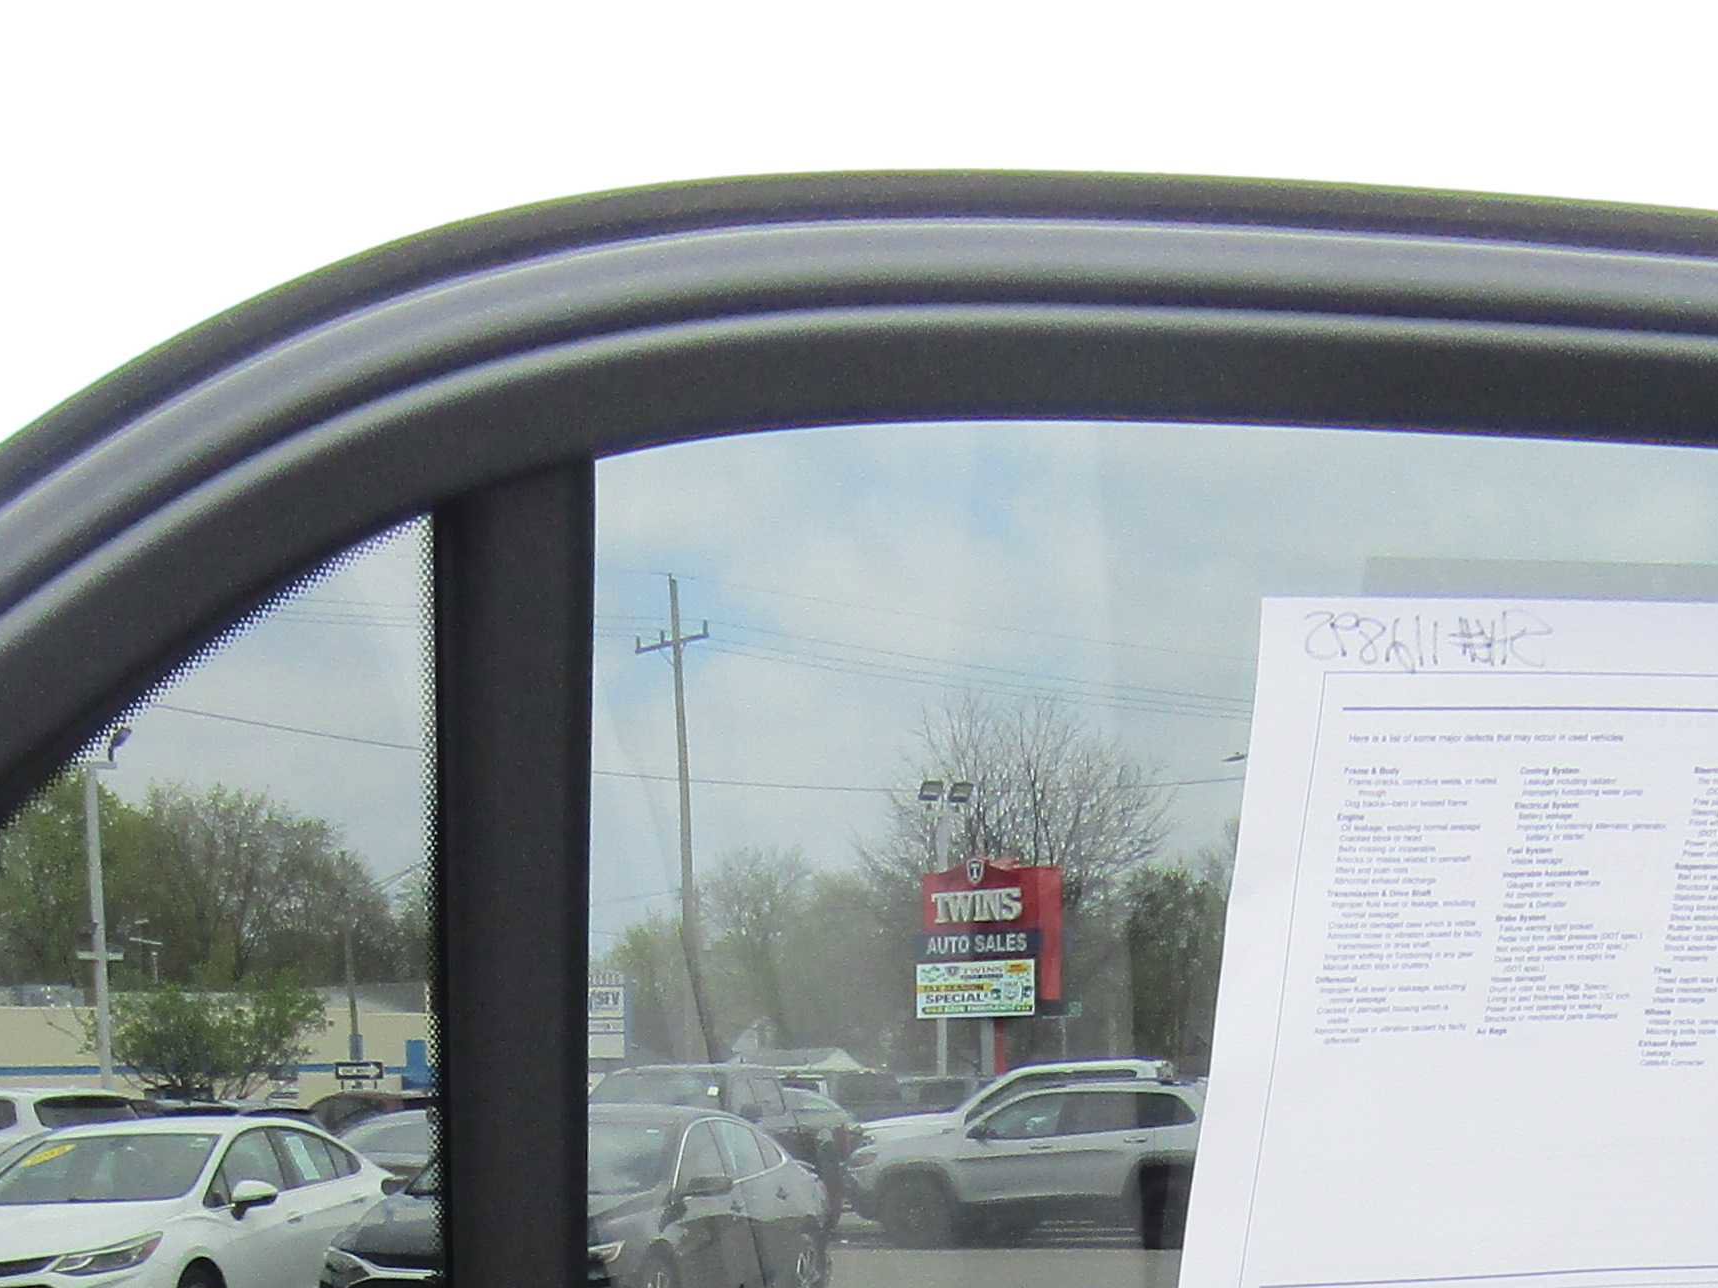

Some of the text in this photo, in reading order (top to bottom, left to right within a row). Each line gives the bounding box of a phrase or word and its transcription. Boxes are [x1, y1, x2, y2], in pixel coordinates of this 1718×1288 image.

[931, 887, 1023, 924] TWINS
[926, 932, 1028, 955] AUTO SALES
